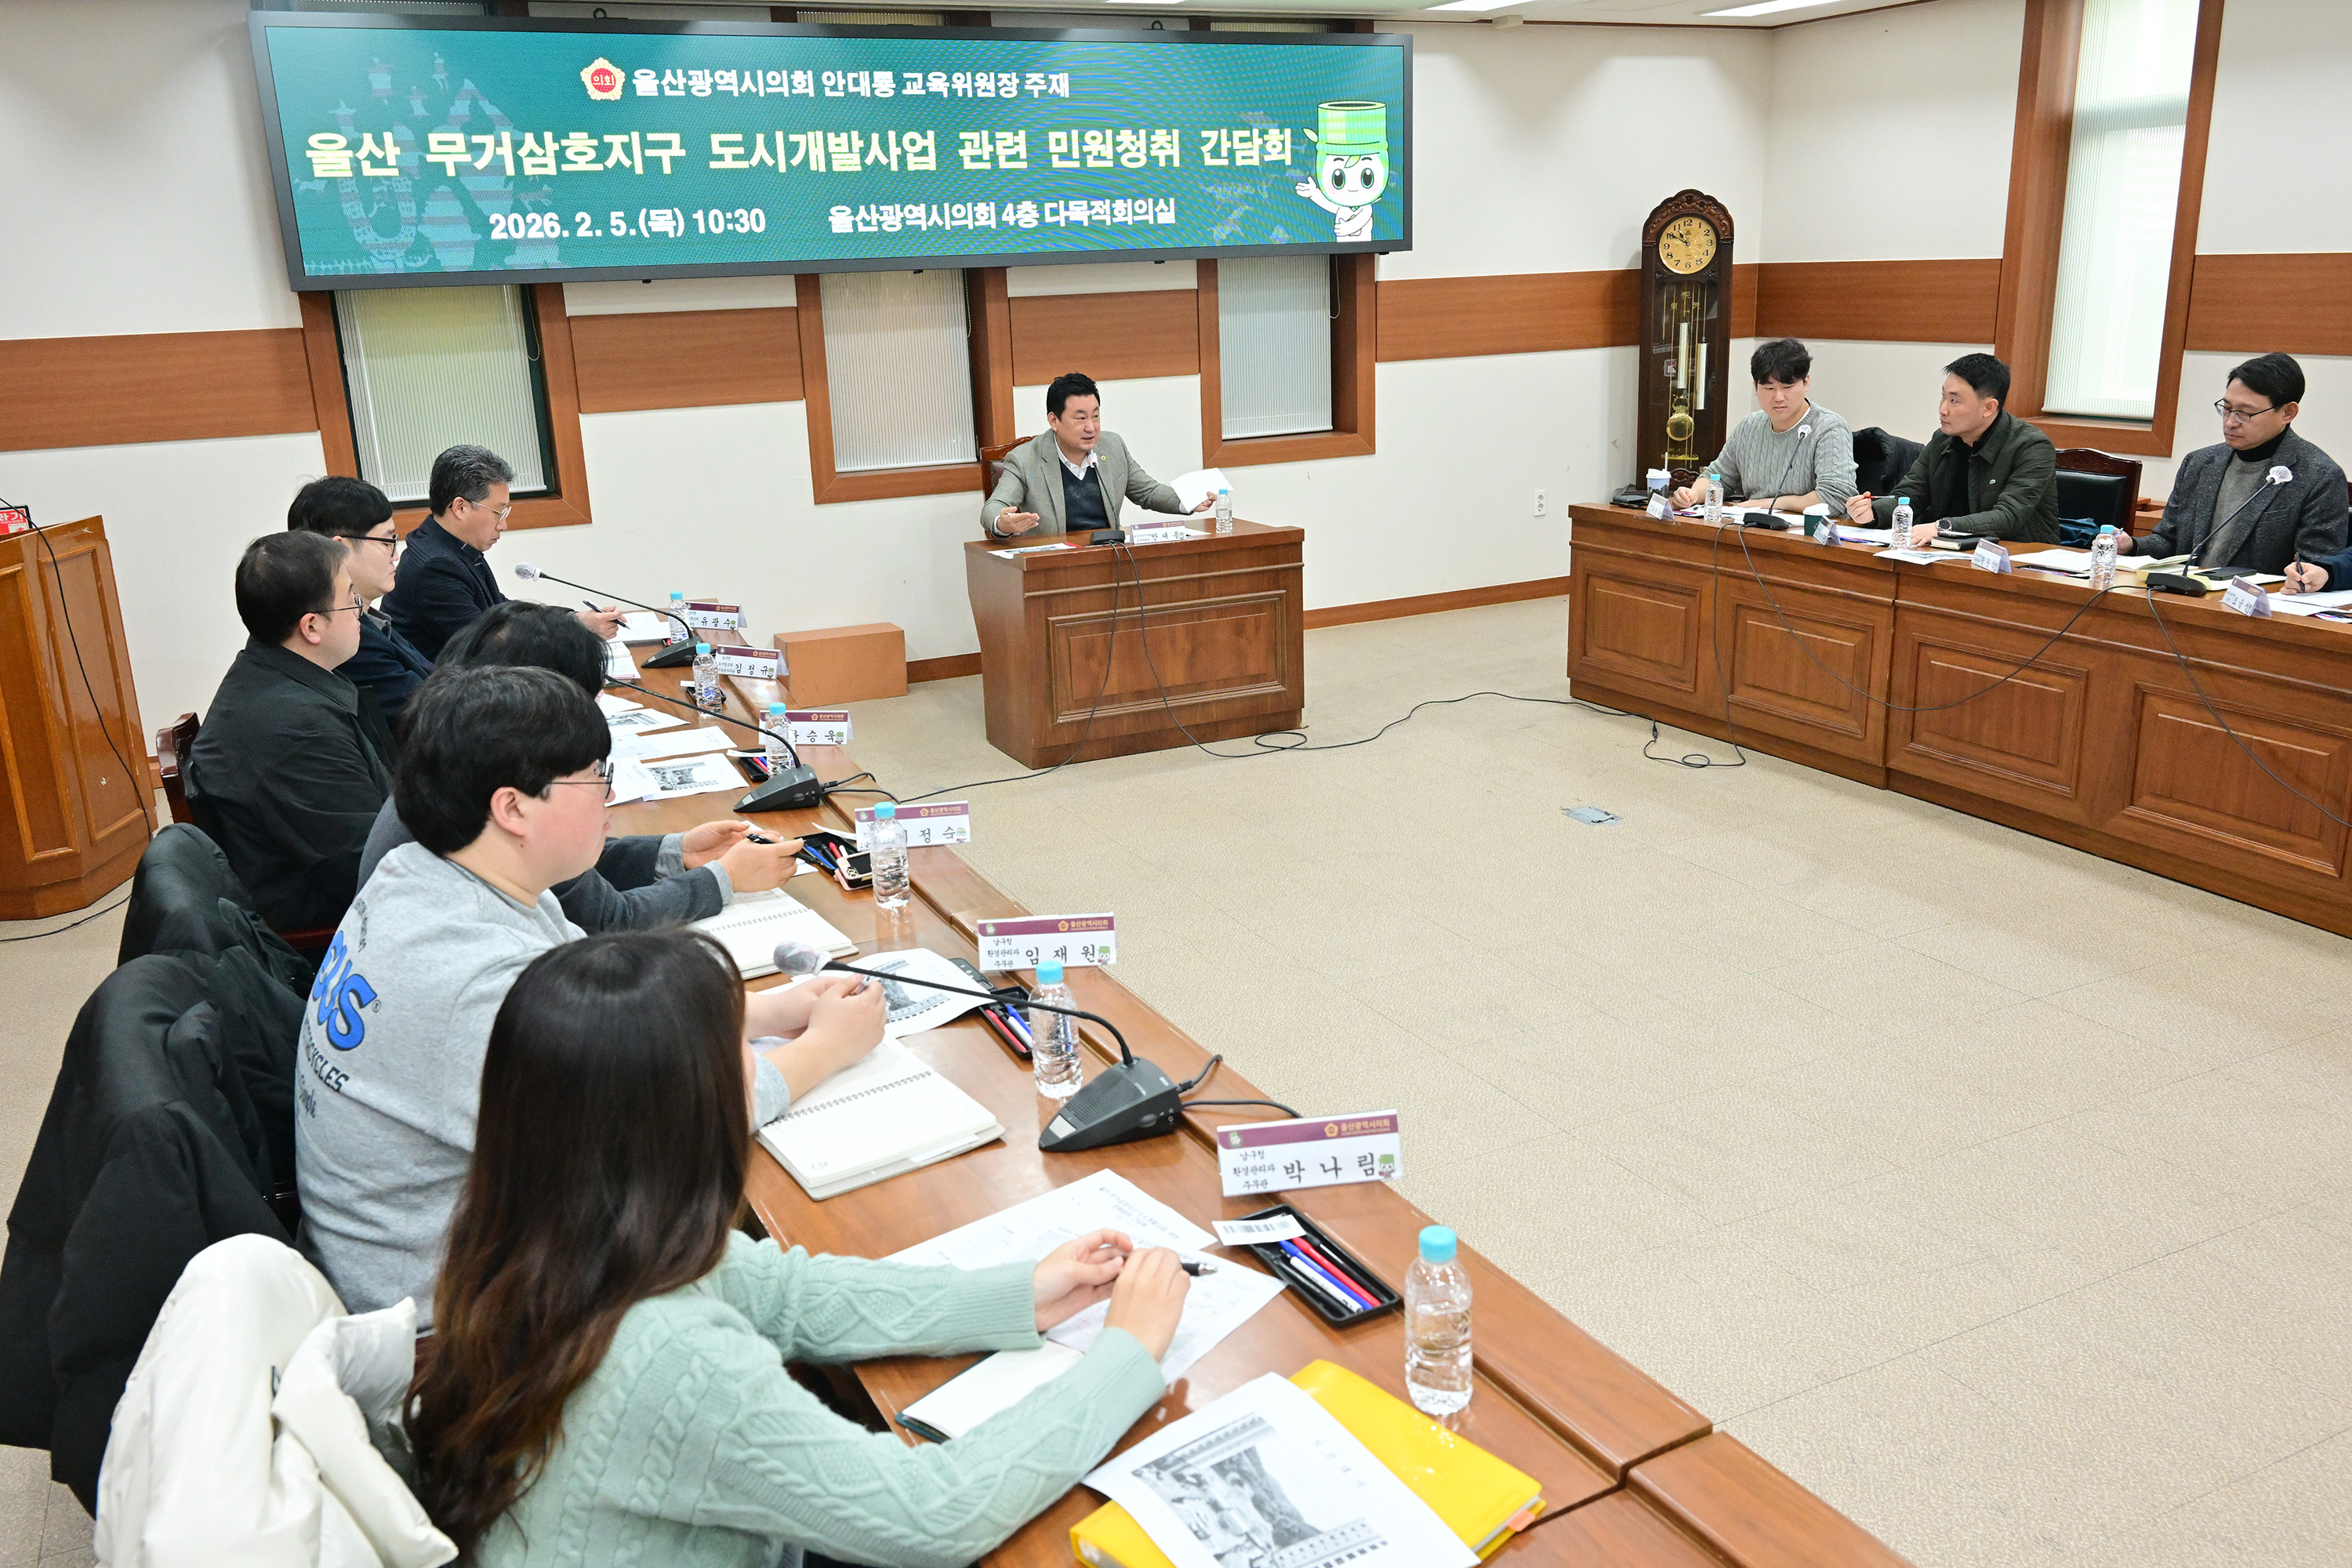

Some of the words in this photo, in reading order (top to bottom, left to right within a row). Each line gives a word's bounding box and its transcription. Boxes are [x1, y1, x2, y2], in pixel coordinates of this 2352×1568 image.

[592, 73, 615, 87] 의회
[633, 68, 815, 97] 울산광역시의회
[902, 71, 1020, 98] 교육위원장
[1024, 72, 1069, 99] 주재
[305, 131, 401, 178] 울산
[426, 131, 686, 177] 무거삼호지구
[709, 130, 937, 173] 도시개발사업
[958, 129, 1028, 170] 관련
[1048, 129, 1180, 169] 민원청취
[1200, 128, 1292, 167] 간담회
[489, 212, 569, 240] 2026.
[575, 212, 602, 238] 2.
[692, 208, 766, 234] 10:30
[828, 201, 996, 234] 울산광역시의회
[1001, 200, 1040, 229] 4층
[1044, 198, 1176, 227] 다목적회의실
[919, 827, 931, 844] 정
[1070, 920, 1109, 928] 울산광역시의회
[1025, 946, 1040, 965] 임
[1052, 945, 1068, 964] 재
[1080, 943, 1096, 963] 원
[1341, 1118, 1391, 1133] 울산광역시의회
[1283, 1160, 1305, 1185] 박
[1319, 1156, 1342, 1181] 나
[1357, 1152, 1374, 1178] 림
